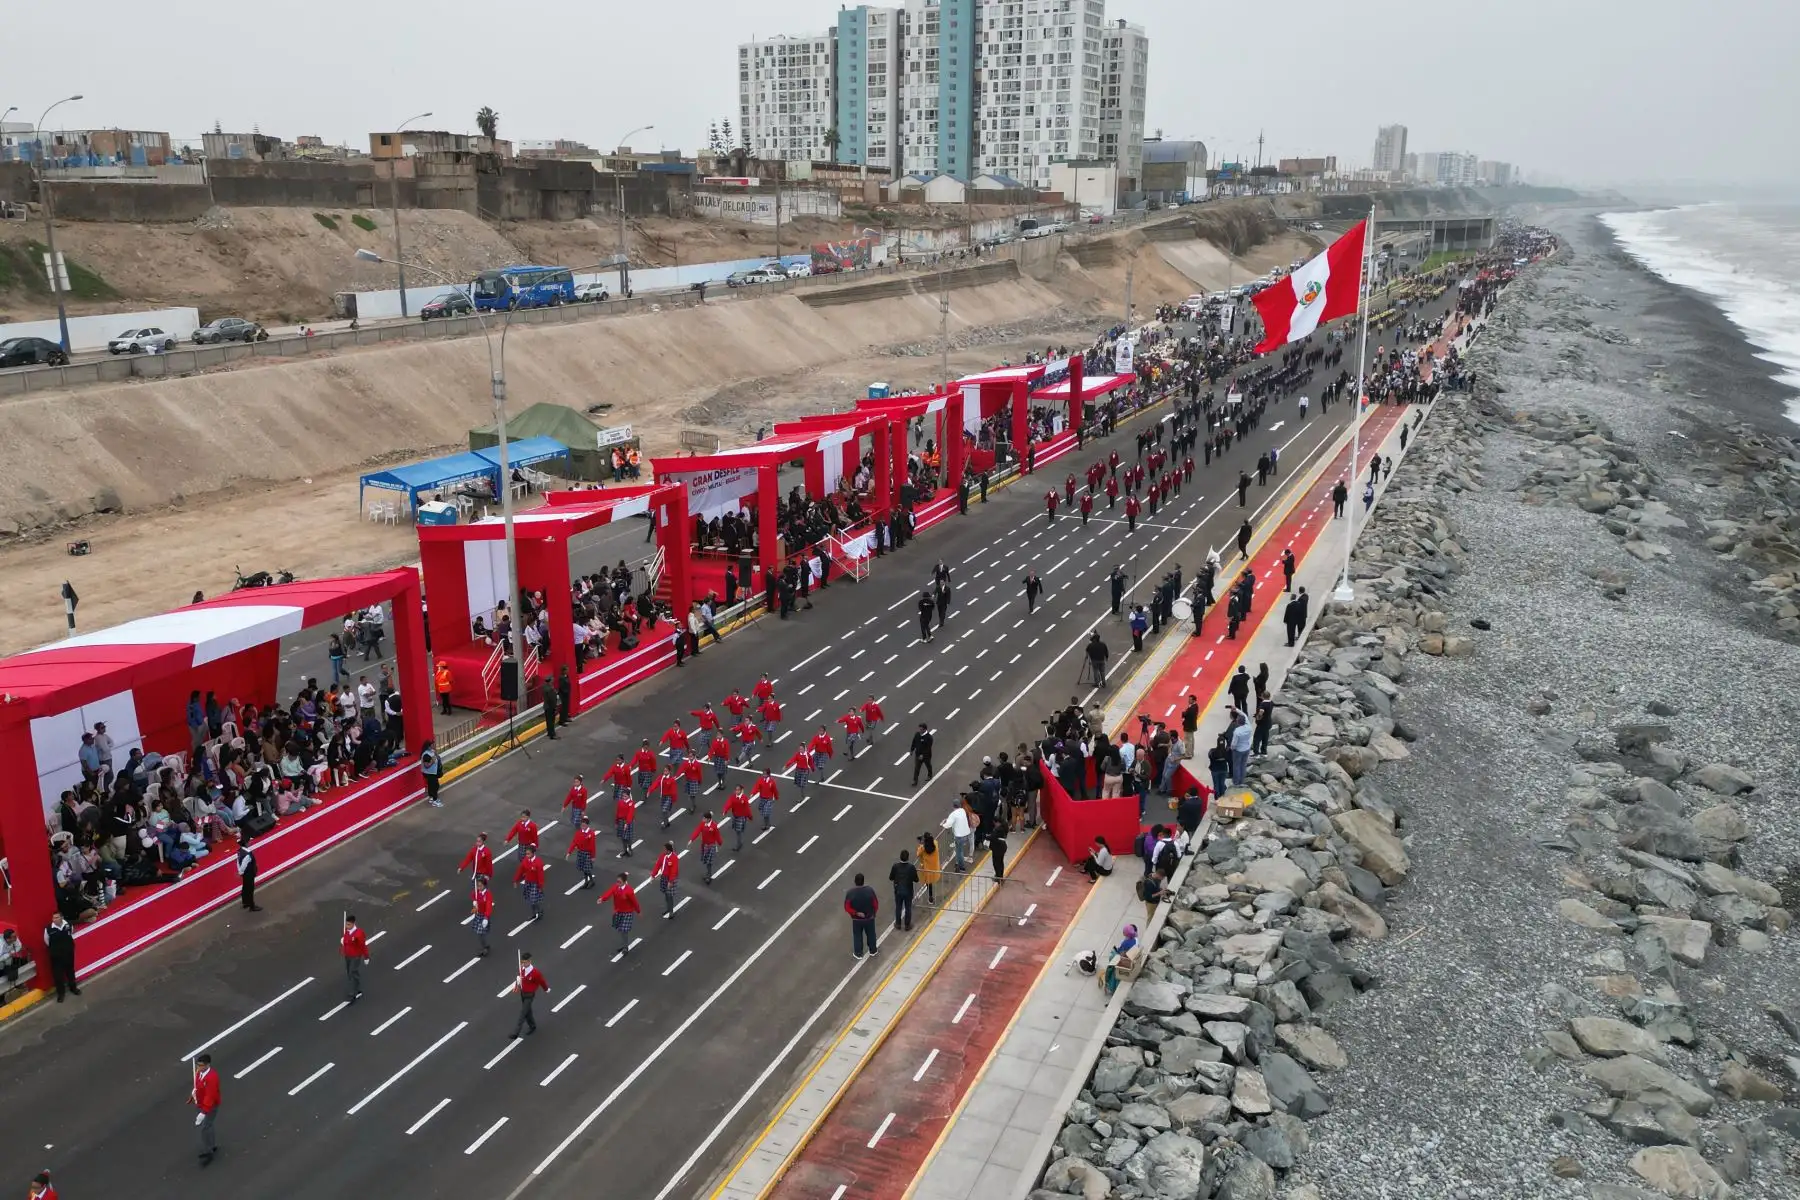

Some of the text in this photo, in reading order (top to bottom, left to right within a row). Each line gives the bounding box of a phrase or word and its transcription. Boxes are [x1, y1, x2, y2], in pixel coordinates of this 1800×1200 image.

[695, 196, 720, 207] NATALY
[722, 201, 757, 212] DELGADO
[692, 472, 713, 487] GRAN
